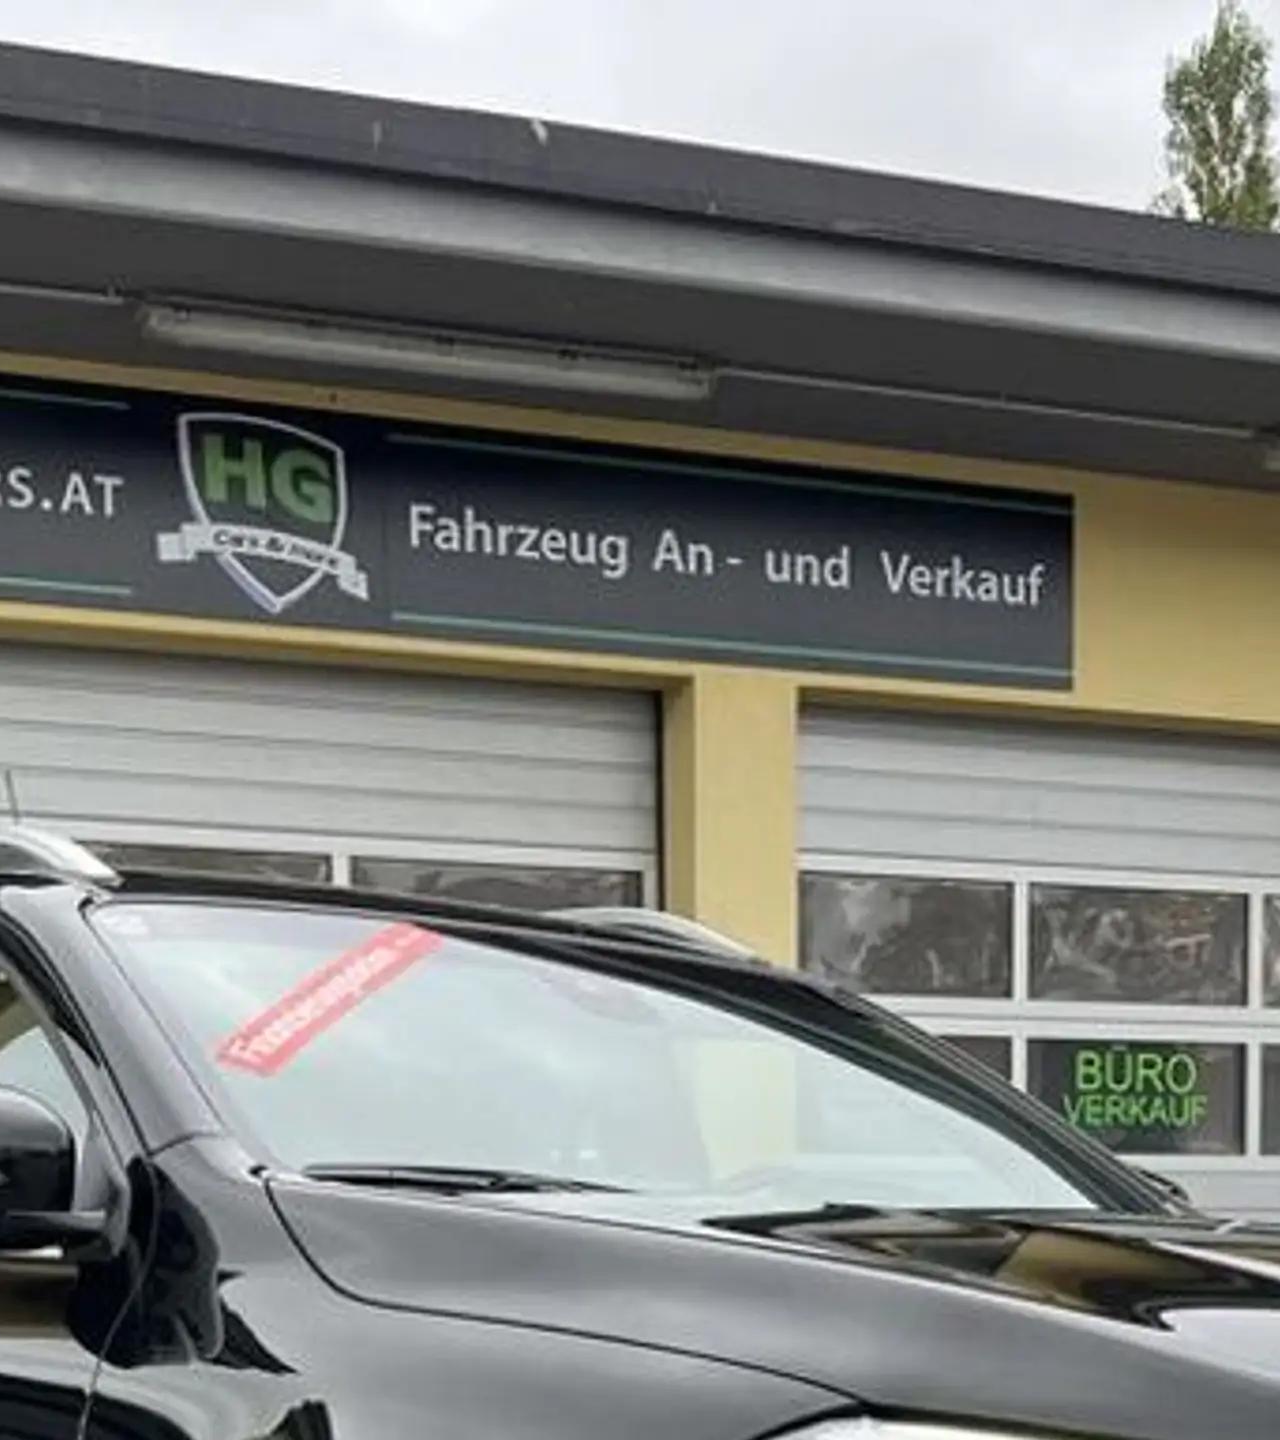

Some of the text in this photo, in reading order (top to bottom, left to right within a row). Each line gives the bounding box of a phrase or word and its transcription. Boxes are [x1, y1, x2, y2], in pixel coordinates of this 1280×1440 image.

[202, 434, 335, 524] HG
[408, 504, 629, 579] Fahrzeug
[765, 545, 852, 589] und
[881, 550, 1045, 606] Verkauf
[1075, 1044, 1197, 1095] BÜRO
[1063, 1092, 1209, 1127] VERKAUF
